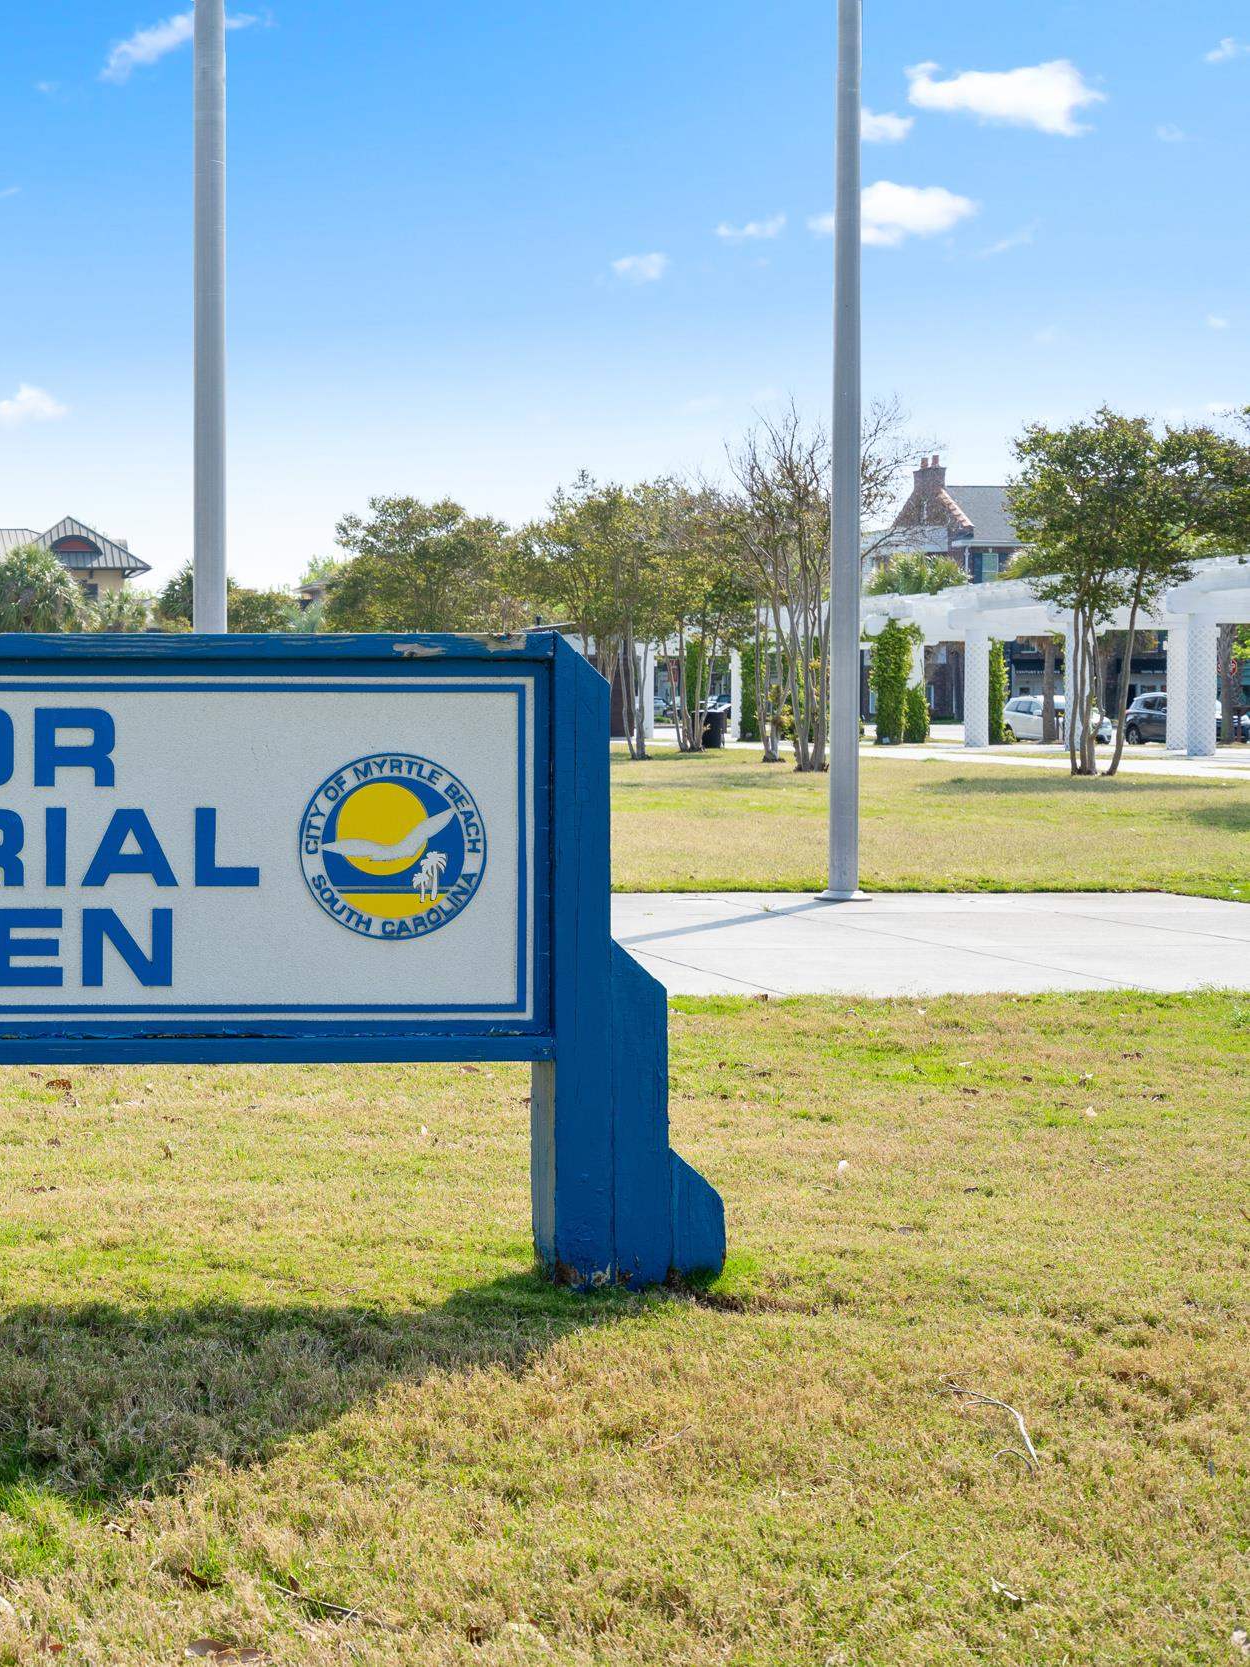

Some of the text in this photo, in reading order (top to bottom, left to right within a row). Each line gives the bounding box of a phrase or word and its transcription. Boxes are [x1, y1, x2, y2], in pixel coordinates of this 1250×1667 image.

[303, 758, 482, 855] CITY OF MYRTLE BEACH
[311, 872, 478, 936] SOUTH CAROLINA
